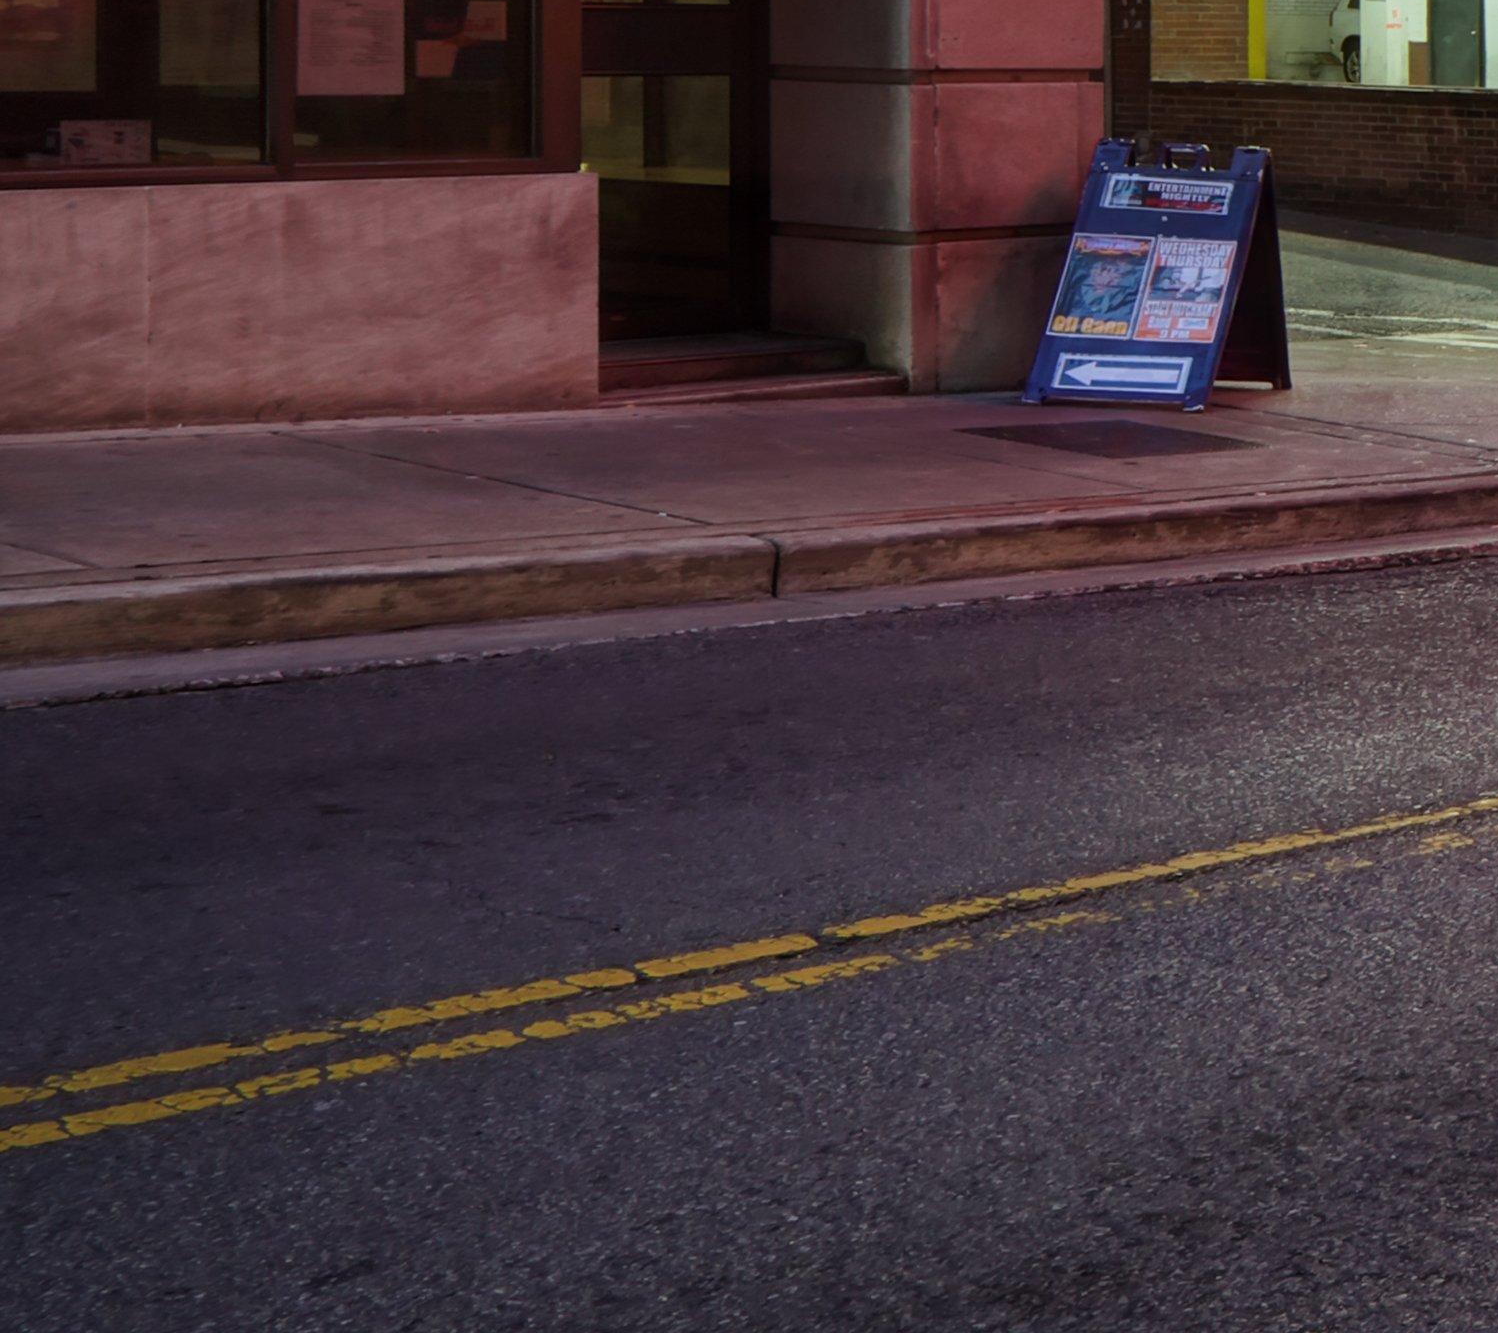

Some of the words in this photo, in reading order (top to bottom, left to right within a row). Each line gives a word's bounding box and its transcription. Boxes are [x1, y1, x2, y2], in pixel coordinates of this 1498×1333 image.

[1147, 181, 1228, 197] ENTERTAINMENT
[1160, 192, 1211, 202] NIGHTLY
[1160, 241, 1233, 257] WEDNESDAY
[1159, 255, 1227, 268] THURSDAY
